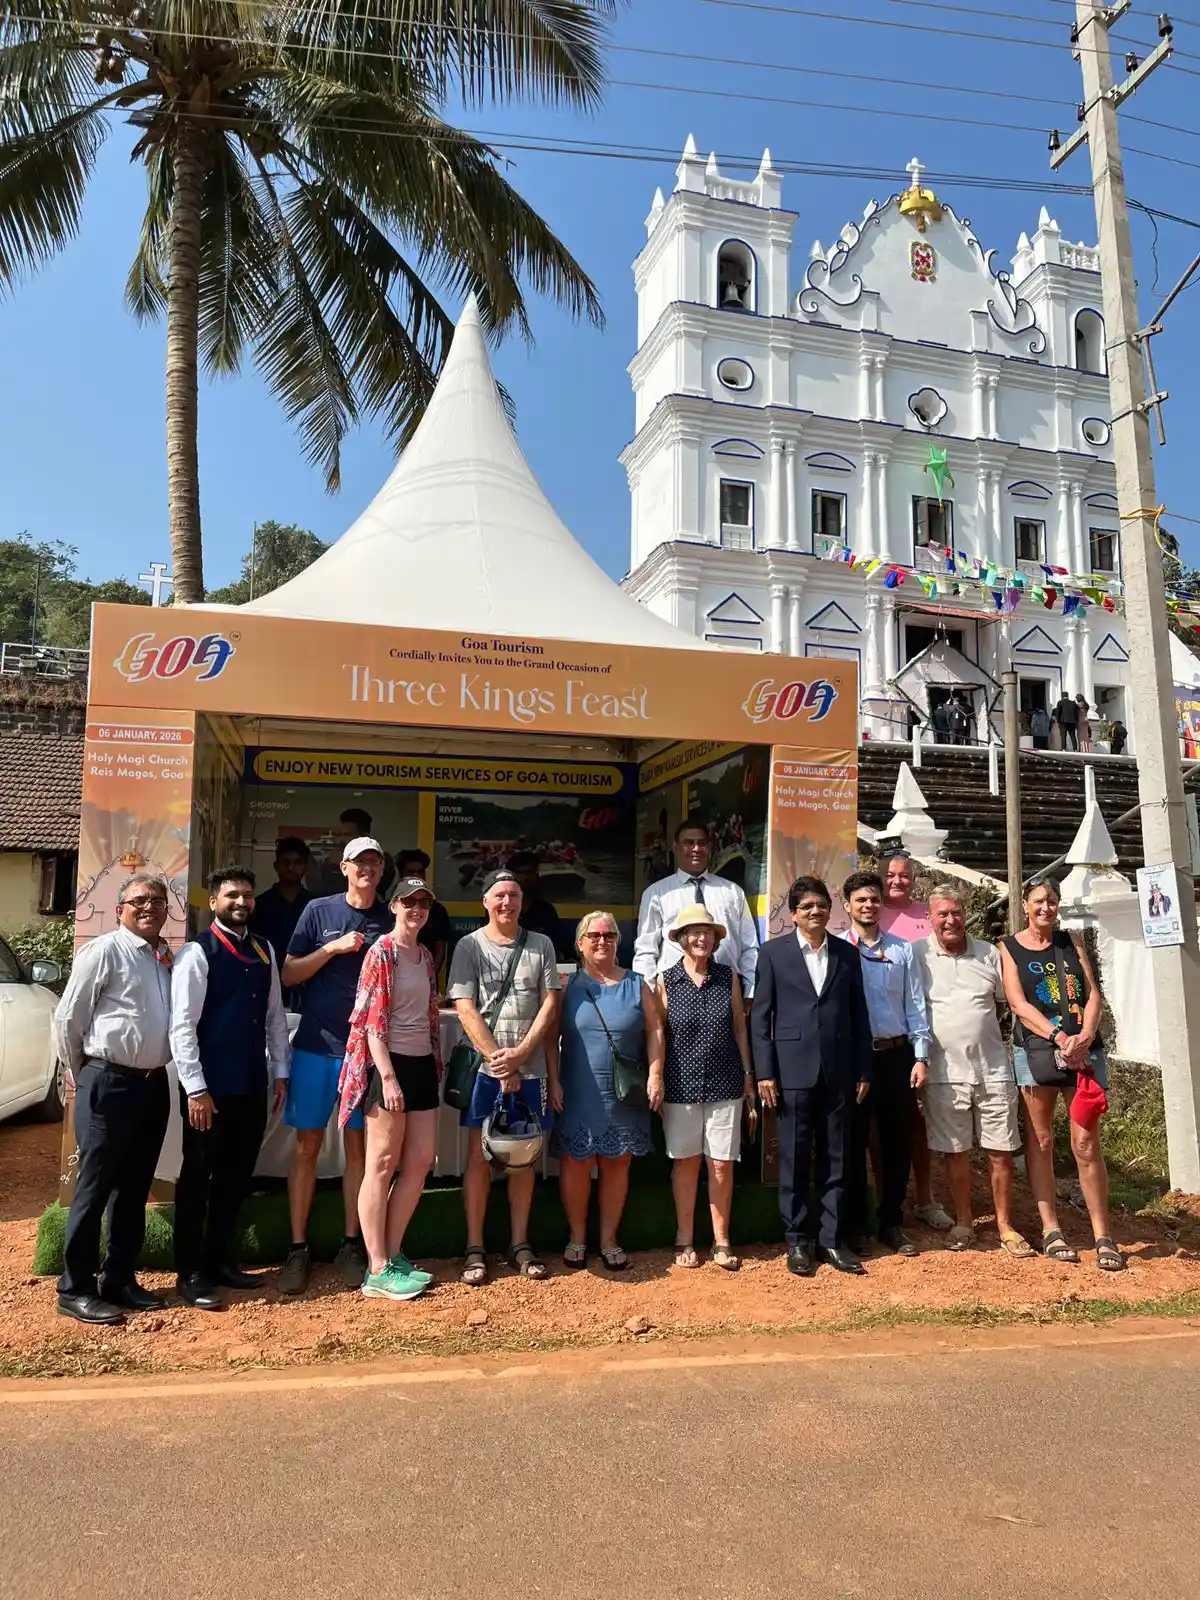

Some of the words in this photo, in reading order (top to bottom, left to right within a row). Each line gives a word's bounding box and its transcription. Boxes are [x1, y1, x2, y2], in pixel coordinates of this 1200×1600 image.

[461, 637, 488, 650] Goa
[491, 640, 544, 654] Tourism
[113, 633, 236, 682] GOA
[389, 648, 437, 663] Cordially
[438, 652, 471, 664] Invites
[474, 655, 493, 665] You
[495, 658, 504, 666] to
[506, 657, 522, 667] the
[524, 659, 555, 669] Grand
[556, 661, 599, 673] Occasion
[601, 664, 612, 674] of
[342, 664, 446, 707] Three
[460, 673, 556, 723] Kings
[565, 680, 651, 720] Feast
[741, 678, 839, 723] GOA
[98, 728, 110, 738] 06
[112, 729, 157, 741] JANUARY,
[160, 731, 182, 741] 2026
[87, 751, 113, 765] Holy
[117, 753, 145, 766] Magi
[149, 754, 188, 766] Church
[90, 766, 113, 776] Reis
[117, 768, 157, 780] Magos,
[161, 768, 184, 779] Goa
[265, 760, 315, 773] ENJOY
[318, 762, 353, 776] NEW
[356, 763, 422, 779] TOURISM
[425, 766, 491, 782] SERVICES
[494, 770, 513, 783] OF
[516, 771, 549, 784] GOA
[552, 772, 612, 787] TOURISM
[794, 766, 829, 777] JANUARY,
[775, 785, 796, 797] Holy
[797, 787, 820, 799] Magi
[822, 788, 854, 799] Church
[438, 806, 463, 814] RIVER
[832, 801, 851, 811] Goa
[438, 815, 475, 824] RAFTING
